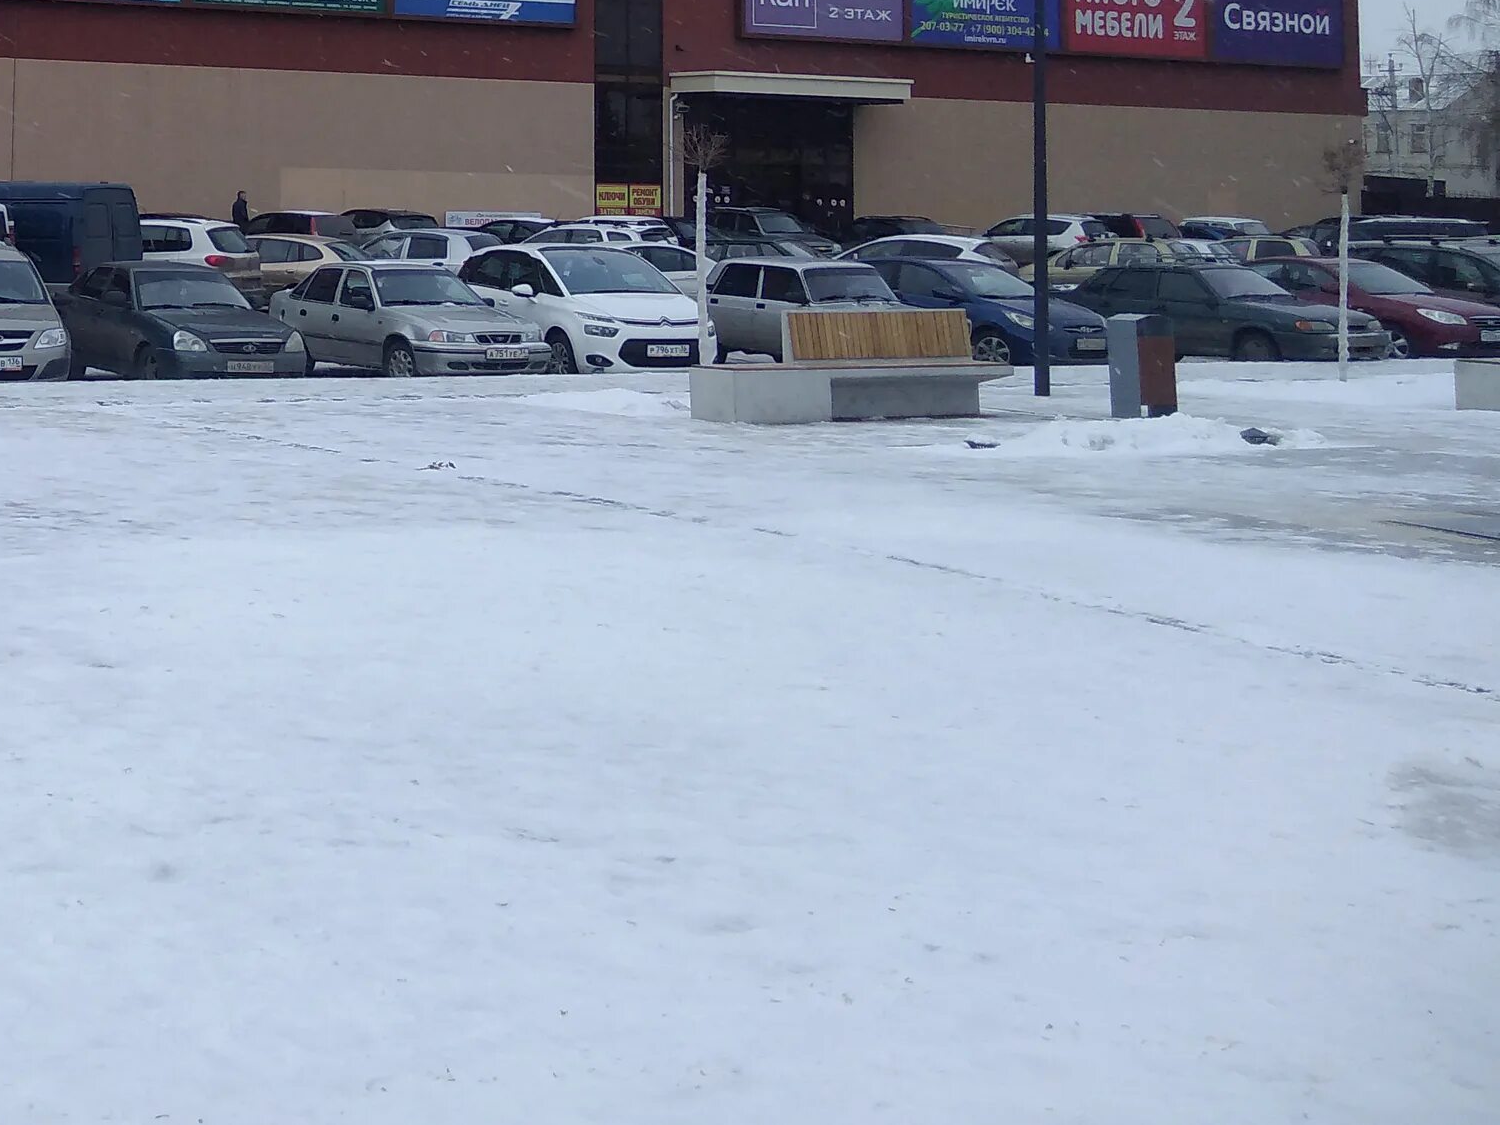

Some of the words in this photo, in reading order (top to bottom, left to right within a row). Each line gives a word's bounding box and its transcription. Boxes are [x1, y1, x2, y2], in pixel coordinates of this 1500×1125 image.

[829, 8, 838, 18] 2
[844, 8, 892, 21] ЭТАЖ
[1075, 9, 1163, 39] МЕБЕЛИ
[1173, 31, 1196, 41] ЭТАЖ
